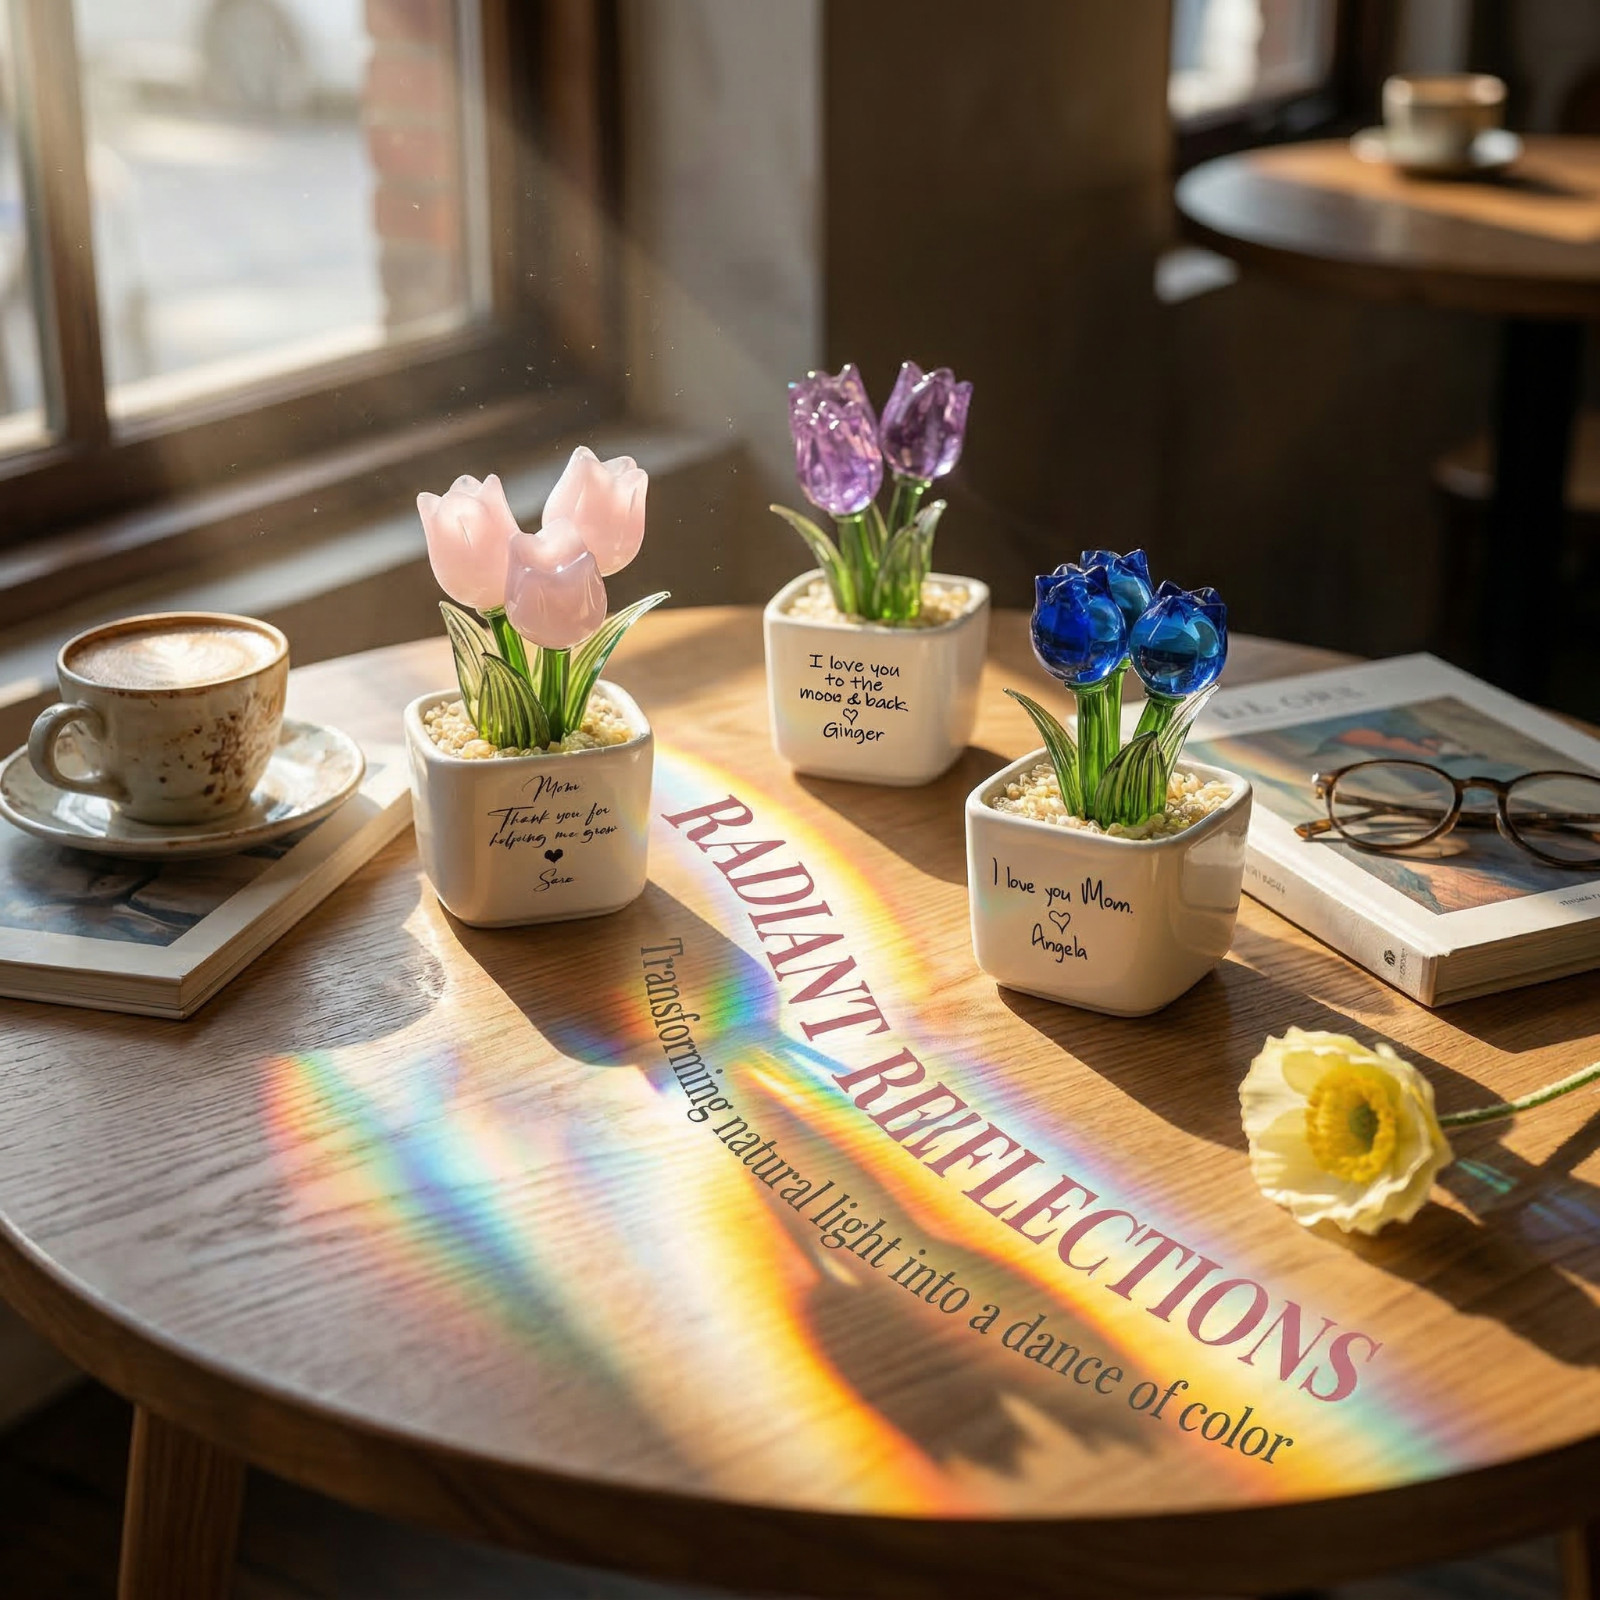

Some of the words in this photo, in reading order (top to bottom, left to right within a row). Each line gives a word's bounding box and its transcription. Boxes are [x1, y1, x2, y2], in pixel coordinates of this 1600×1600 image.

[809, 654, 823, 668] I
[830, 655, 865, 673] love
[870, 663, 900, 678] you
[825, 673, 845, 687] to
[850, 676, 884, 692] the
[823, 722, 885, 745] Ginger
[522, 775, 580, 802] Mom
[487, 806, 551, 833] Thank
[556, 811, 583, 824] you
[584, 802, 611, 826] for
[489, 830, 547, 850] helping
[554, 830, 578, 841] me
[580, 824, 619, 843] grow
[992, 857, 998, 886] I
[1006, 866, 1036, 894] love
[1044, 887, 1071, 907] you
[1081, 877, 1134, 914] Mom.
[1031, 923, 1088, 963] Angela
